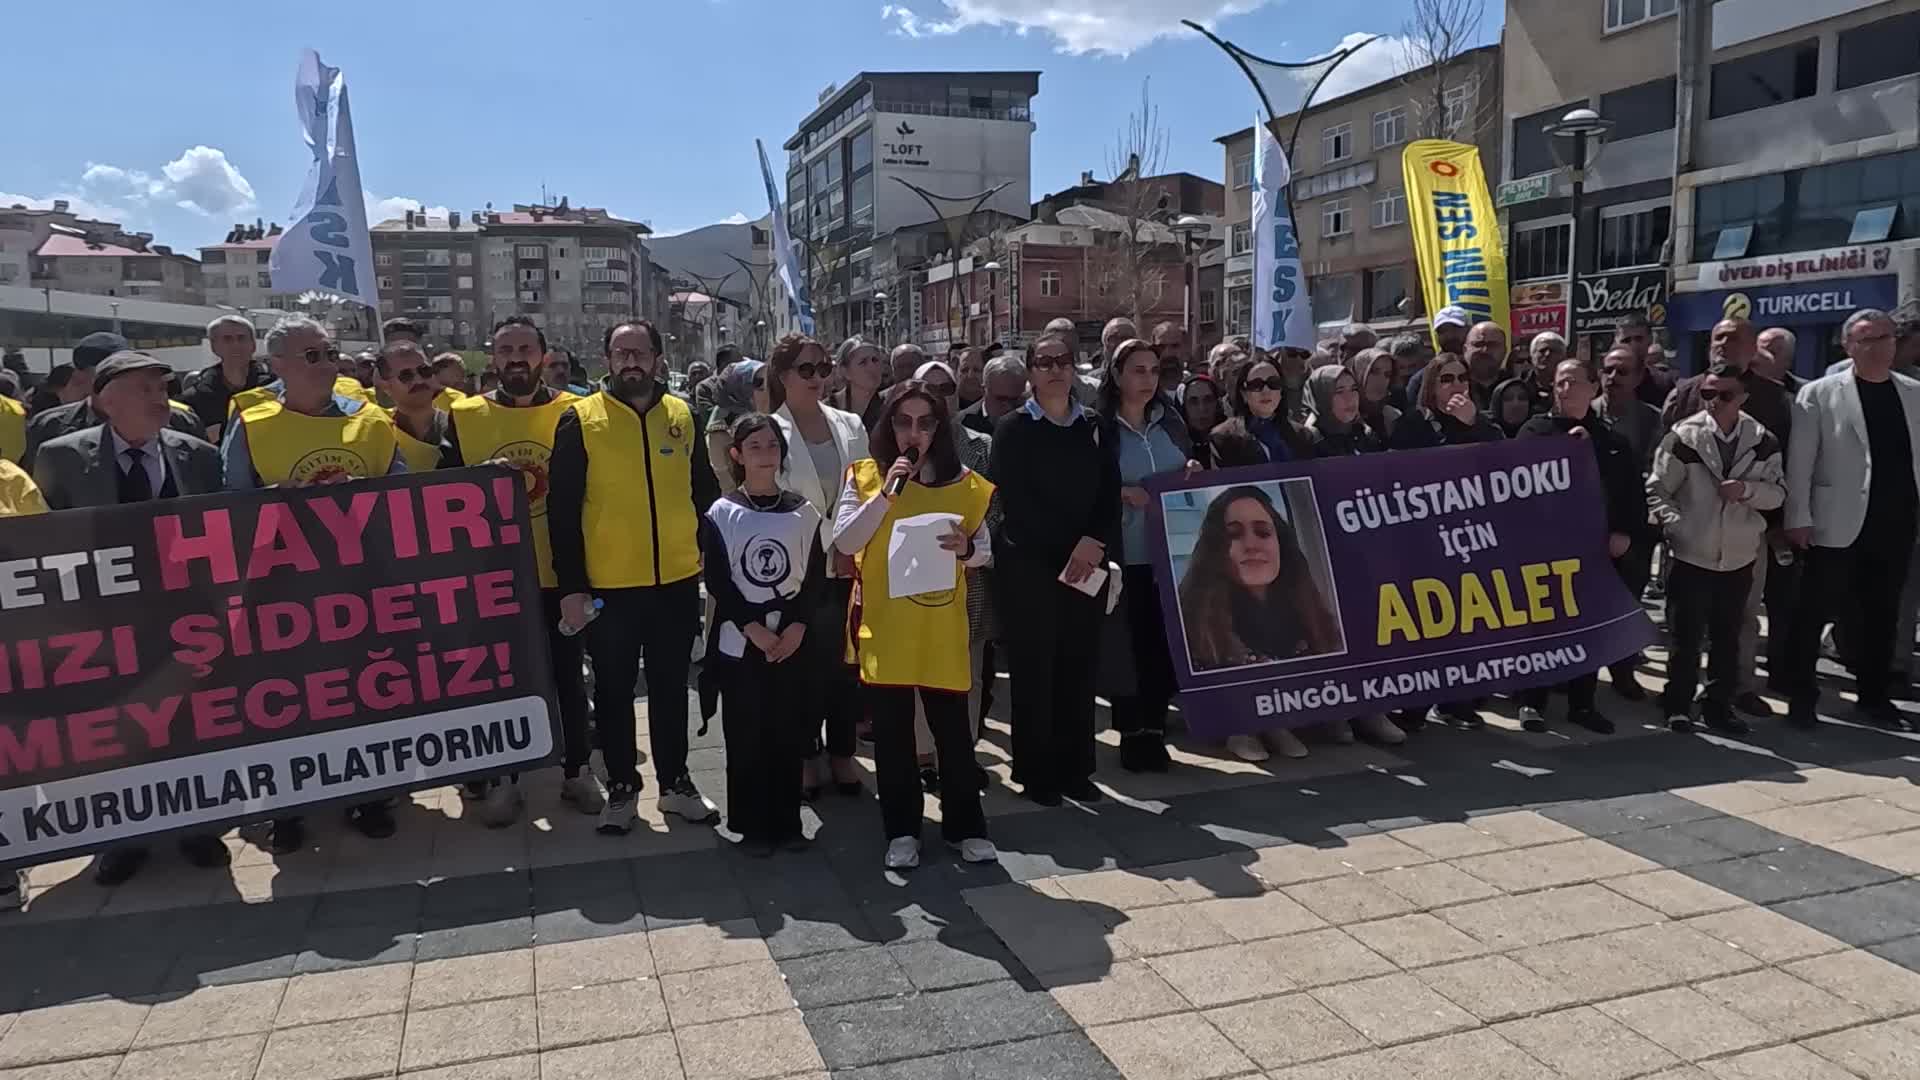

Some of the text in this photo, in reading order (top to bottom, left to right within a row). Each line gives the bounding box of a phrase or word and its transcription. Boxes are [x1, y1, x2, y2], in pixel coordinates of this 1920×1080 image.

[891, 144, 923, 156] LOFT
[1432, 190, 1478, 240] SEN
[1261, 186, 1300, 345] ESK
[1576, 276, 1663, 316] Sedat
[1765, 258, 1793, 281] DİŞ
[1796, 248, 1867, 273] KLİNİĞİ
[1530, 311, 1560, 325] THY
[1756, 290, 1857, 315] TURKCELL
[1335, 458, 1571, 533] GÜLİSTAN DOKU
[0, 477, 521, 609] ETE HAYIR!
[1438, 519, 1499, 563] İÇİN
[170, 569, 521, 678] ŞİDDETE
[1377, 558, 1581, 646] ADALET
[0, 642, 516, 775] MEYECEĞİZ!
[1255, 644, 1588, 716] BİNGÖL KADIN PLATFORMU
[23, 763, 278, 842] KURUMLAR
[290, 716, 532, 791] PLATFORMU
